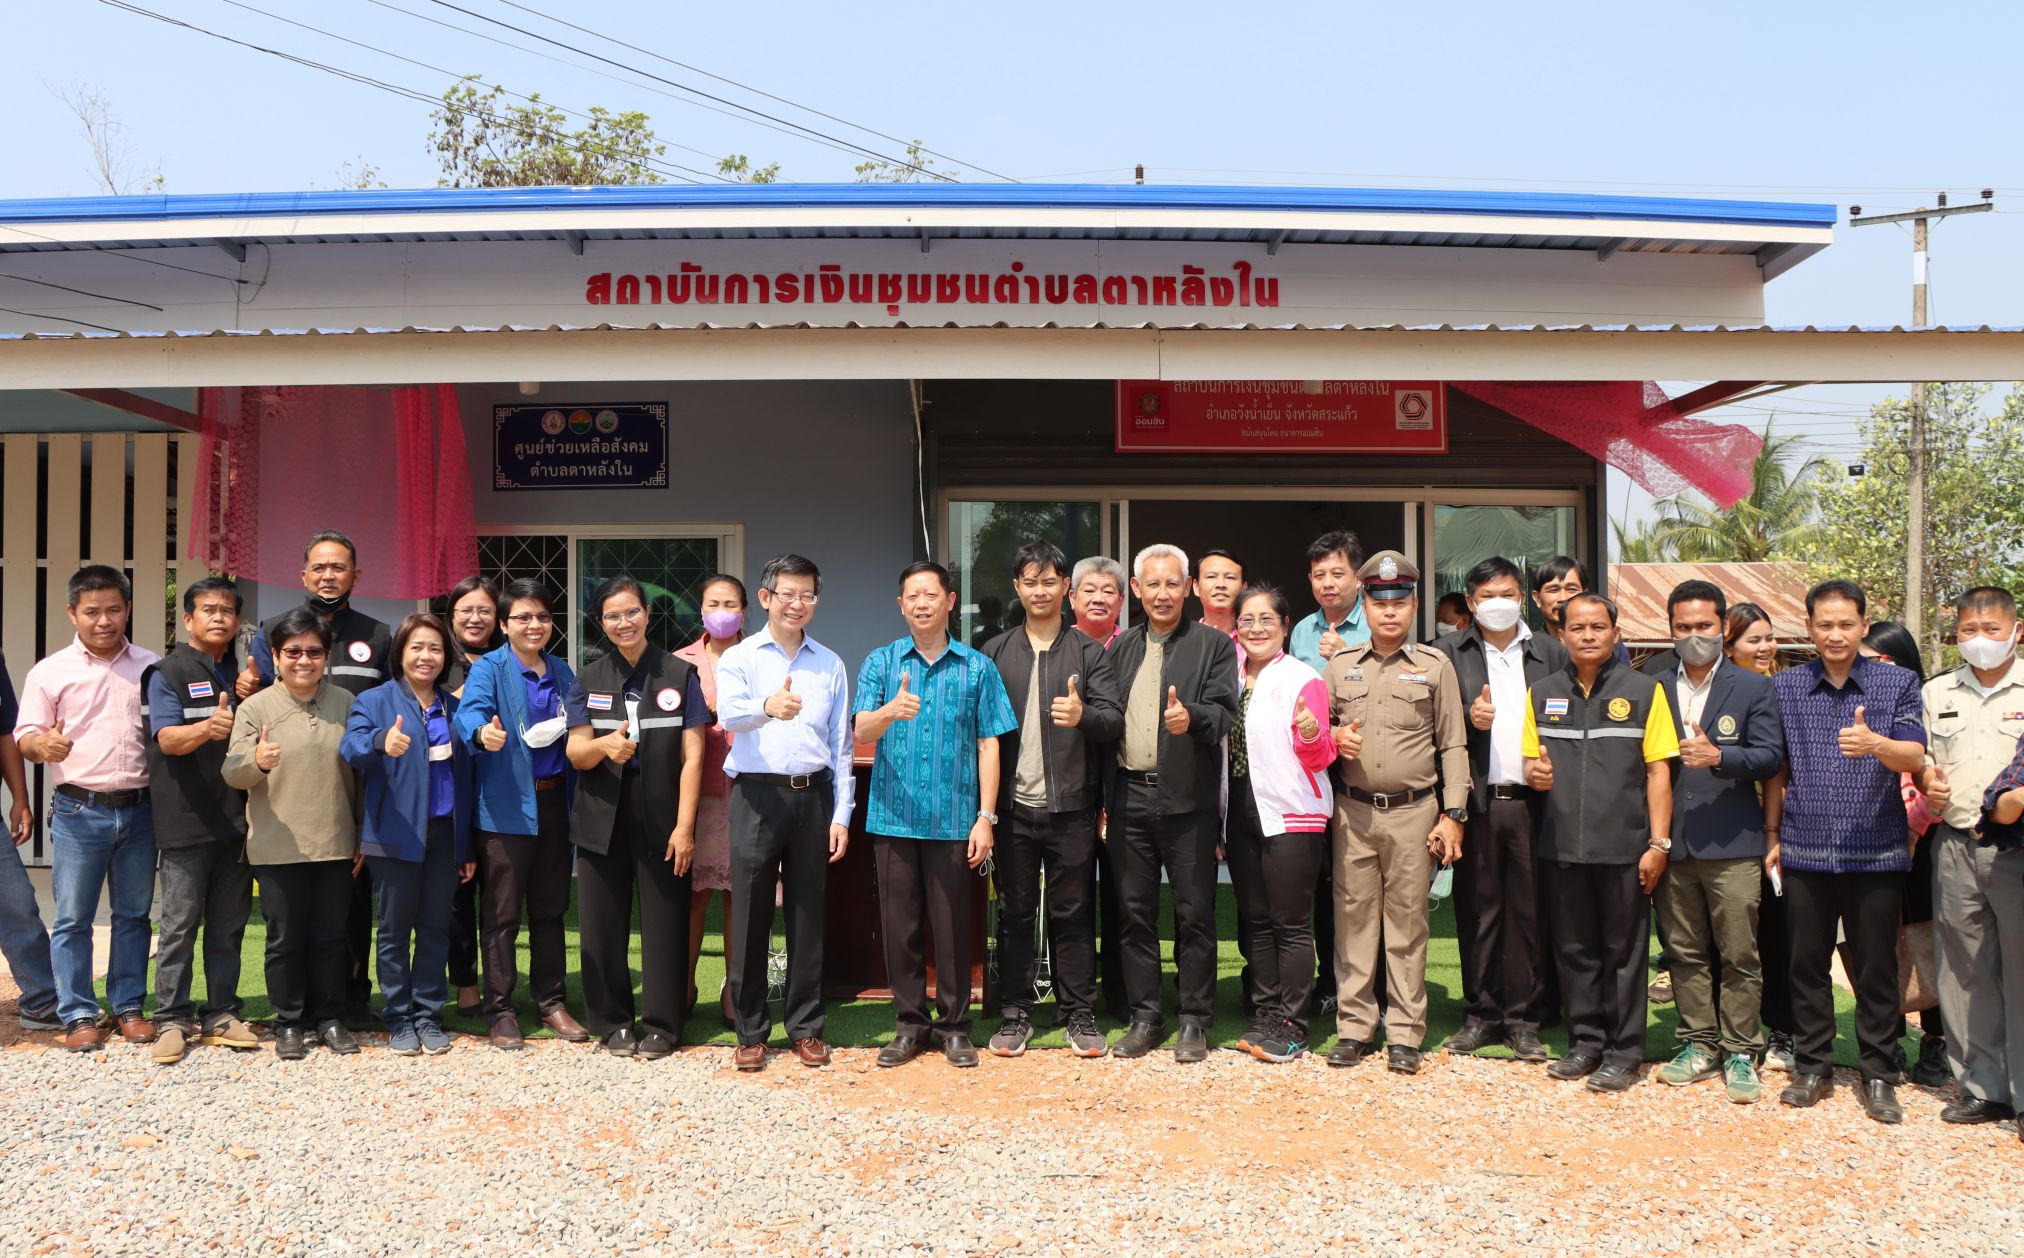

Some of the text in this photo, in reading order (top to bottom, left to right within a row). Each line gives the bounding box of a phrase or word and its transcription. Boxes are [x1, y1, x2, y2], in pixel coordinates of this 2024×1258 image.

[586, 260, 1279, 316] สถาบันการเงินชุมชนตำบลตาหลังใน
[1285, 402, 1358, 421] จังหวัดสระแก้ว
[514, 436, 649, 460] ศูนย์ช่วยเหลือสังคม
[530, 458, 633, 477] ตำบลตาหลังใน
